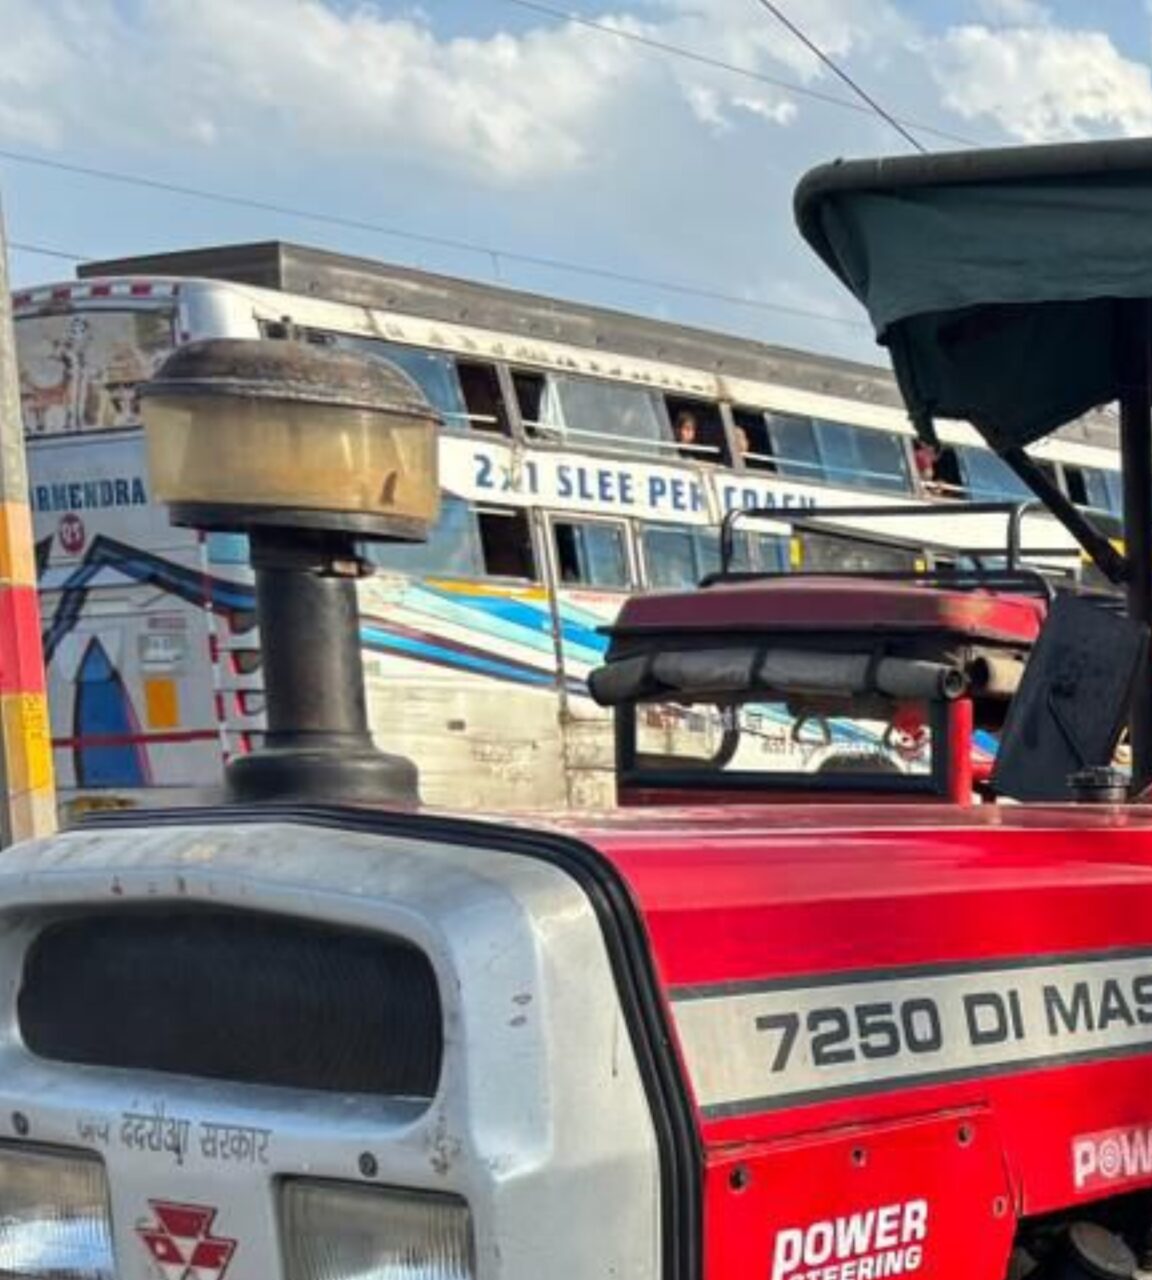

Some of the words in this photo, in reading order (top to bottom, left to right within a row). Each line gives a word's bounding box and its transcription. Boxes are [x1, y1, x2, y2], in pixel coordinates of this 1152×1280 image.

[31, 476, 147, 512] RMENDRA
[555, 464, 635, 504] SLEE
[755, 998, 943, 1073] 7250
[965, 990, 1025, 1047] DI
[200, 1121, 273, 1164] सरकार
